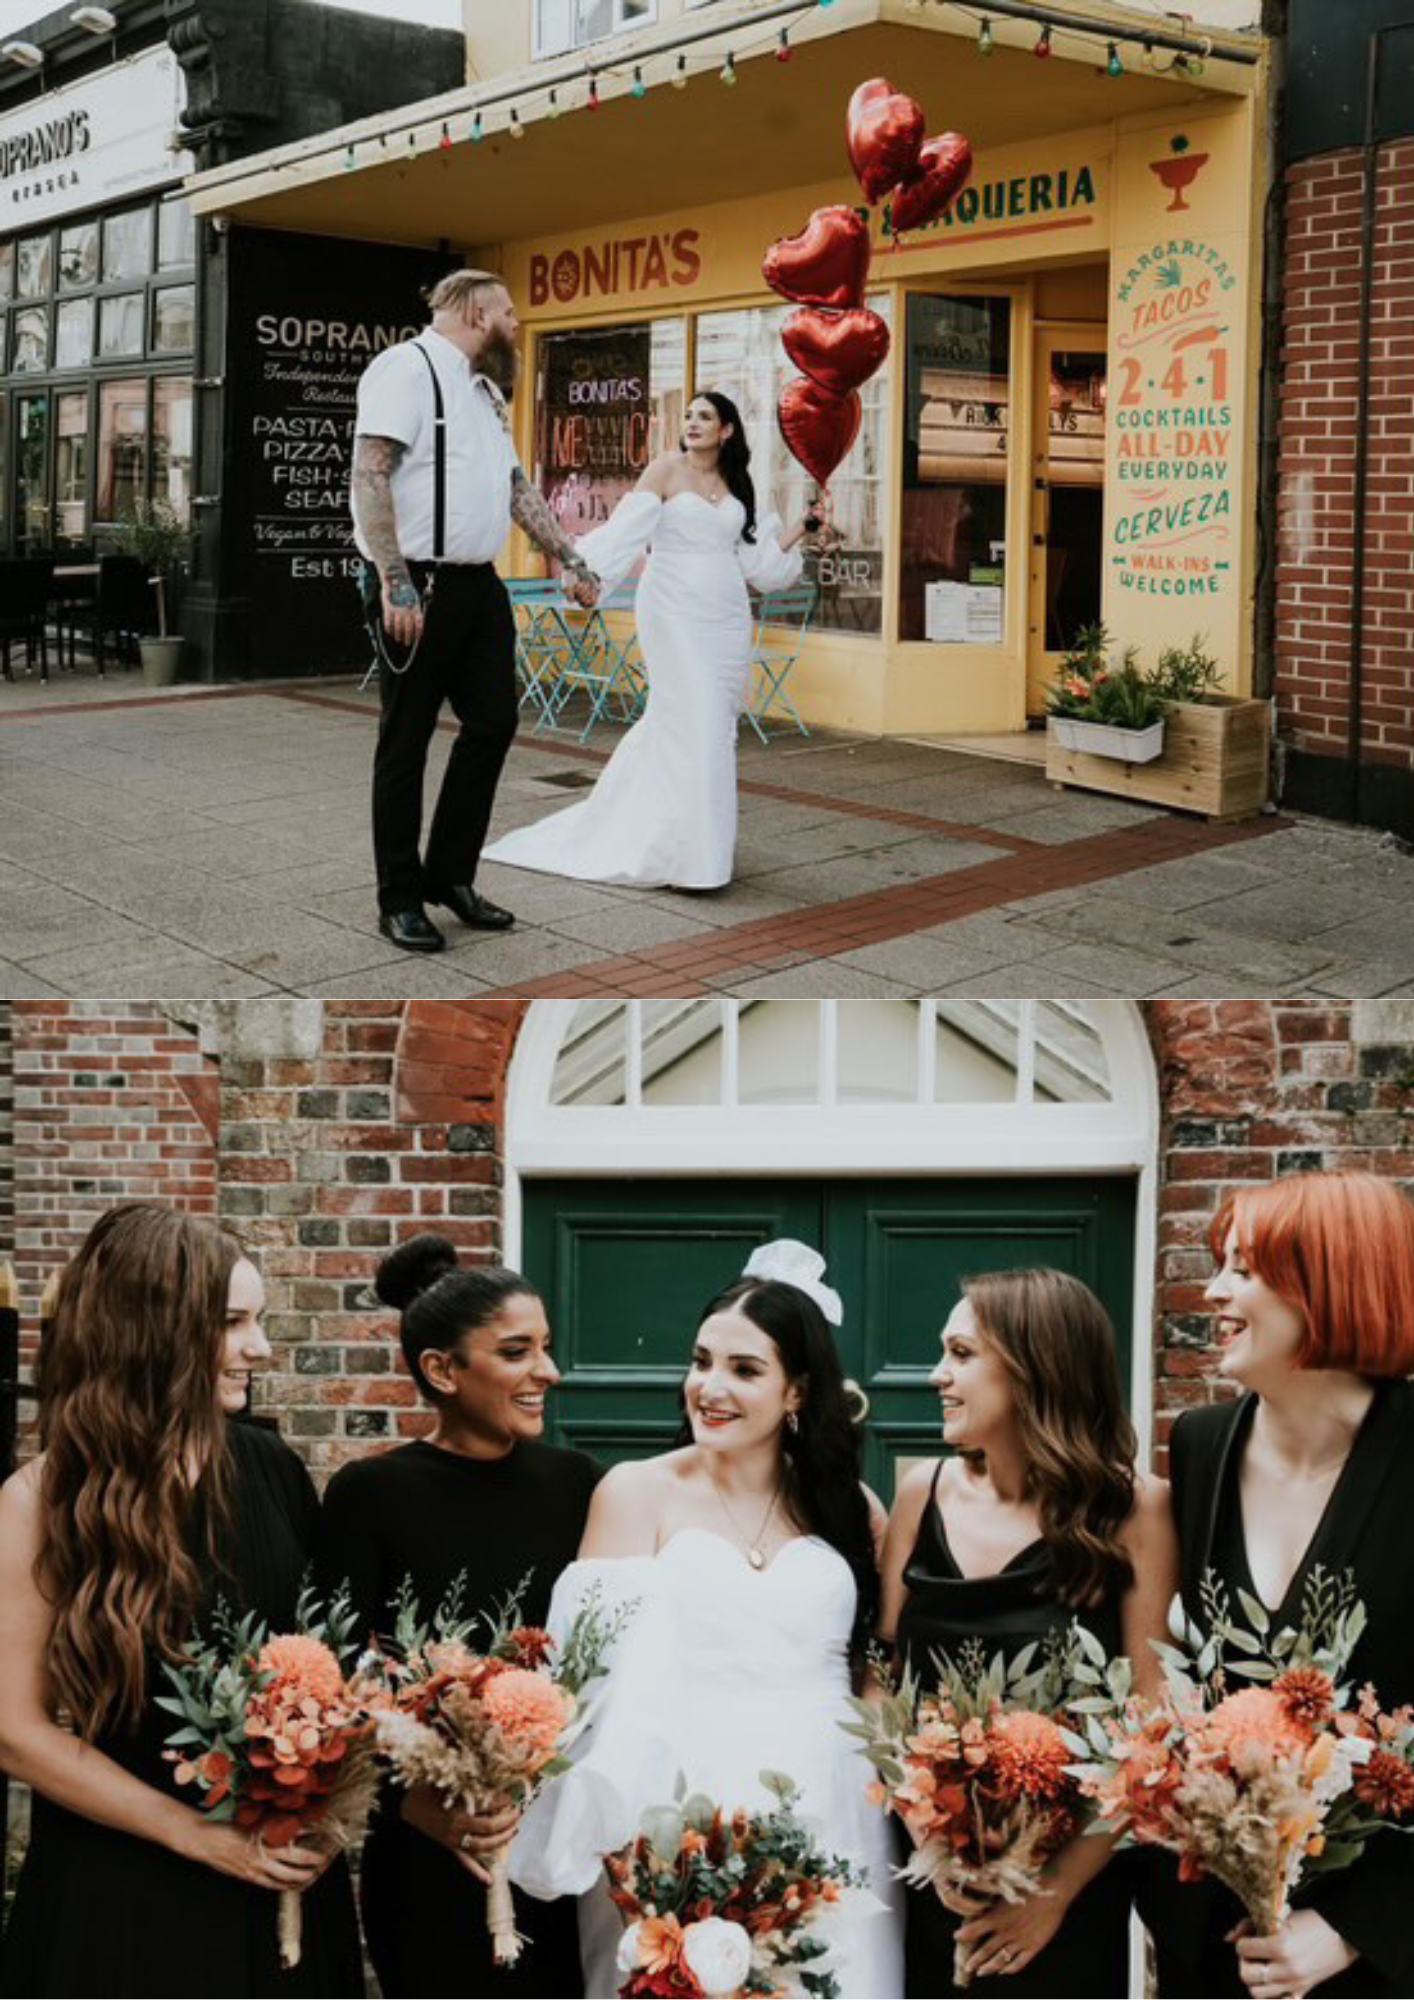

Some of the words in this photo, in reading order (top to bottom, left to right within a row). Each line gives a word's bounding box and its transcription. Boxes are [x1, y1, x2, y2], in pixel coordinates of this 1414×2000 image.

[918, 164, 1097, 230] QUERIA
[530, 228, 701, 307] BONITA'S
[1117, 240, 1237, 302] MARGARITAS
[1133, 279, 1211, 333] TACOS
[1117, 407, 1231, 427] COCKTAILS
[1118, 430, 1231, 457] ALL-DAY
[1118, 461, 1227, 479] EVERYDAY
[1115, 489, 1230, 543] CERVEZA
[253, 523, 306, 546] Vegan
[291, 557, 334, 578] Est
[819, 558, 870, 588] BAR
[1131, 554, 1211, 572] WALK-INS
[1119, 570, 1219, 596] WELCOME
